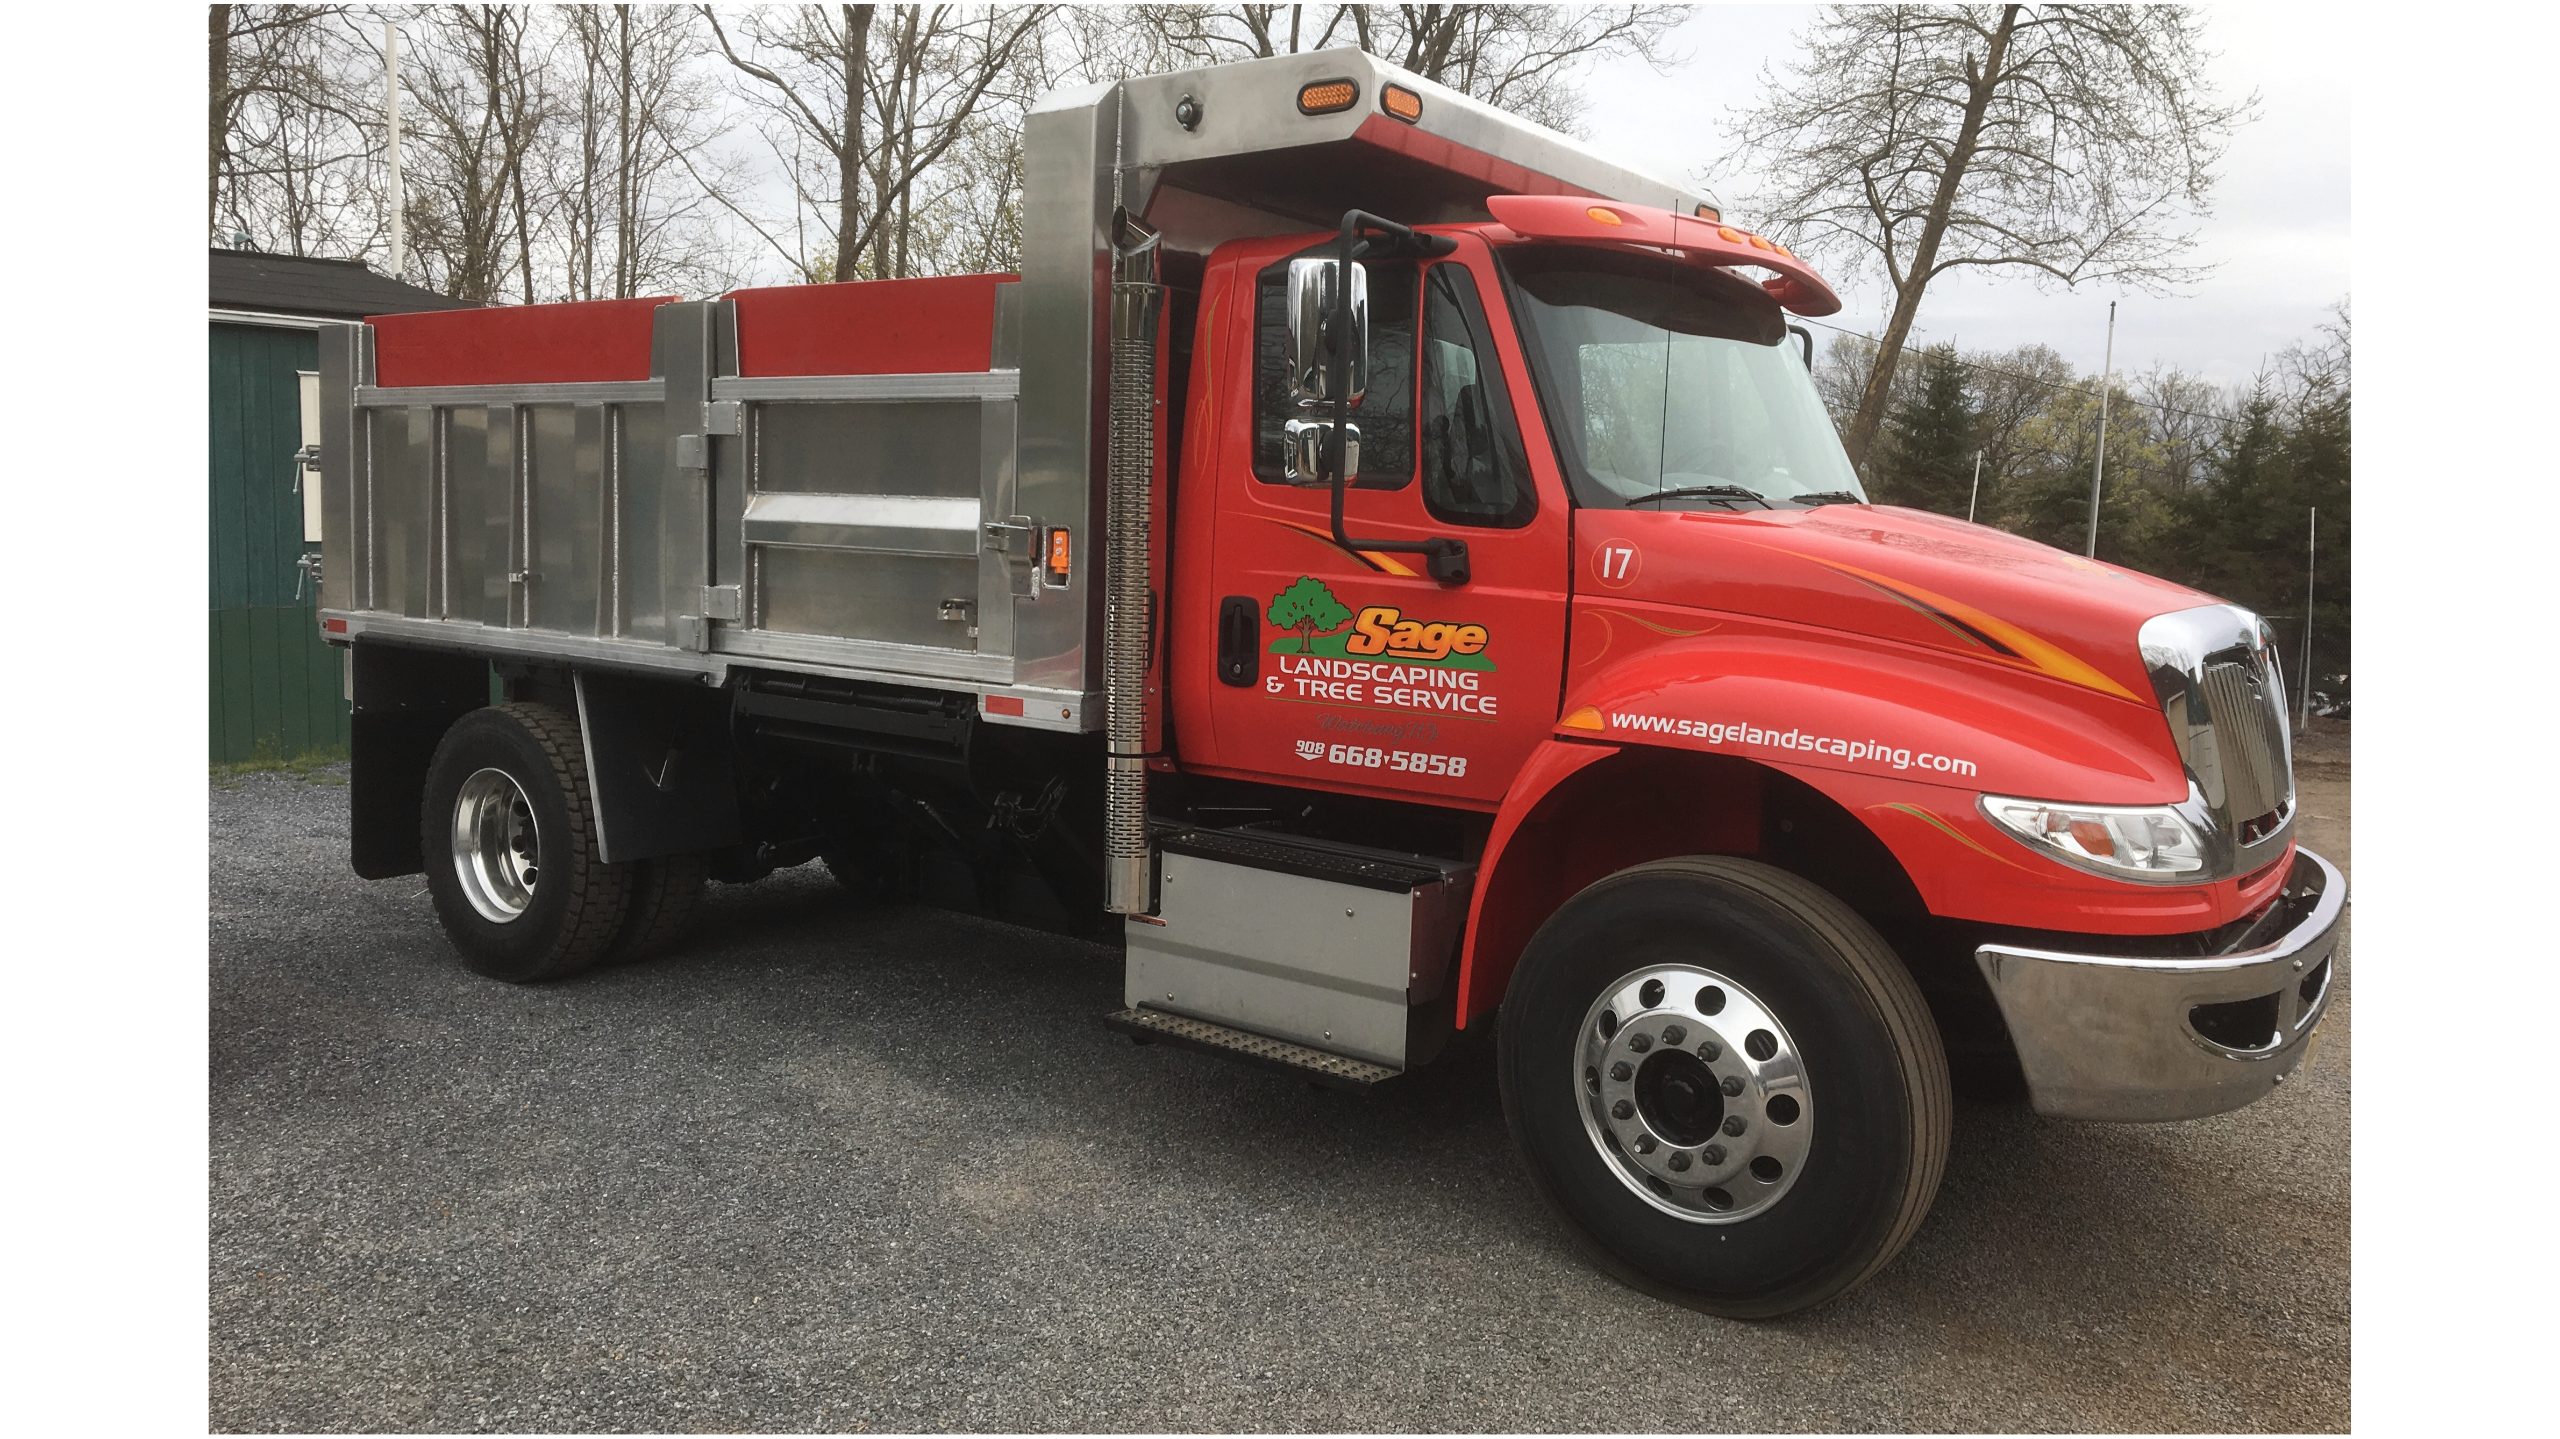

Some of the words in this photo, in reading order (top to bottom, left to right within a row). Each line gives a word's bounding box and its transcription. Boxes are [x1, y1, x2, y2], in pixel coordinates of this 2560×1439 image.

[1603, 547, 1634, 579] 17
[1346, 606, 1489, 660] Sage
[1280, 656, 1479, 691] LANDSCAPING
[1266, 675, 1285, 693] &
[1293, 678, 1363, 702] TREE
[1373, 687, 1497, 715] SERVICE
[1295, 739, 1325, 755] 908
[1612, 712, 1977, 777] www.sagelandscaping.com
